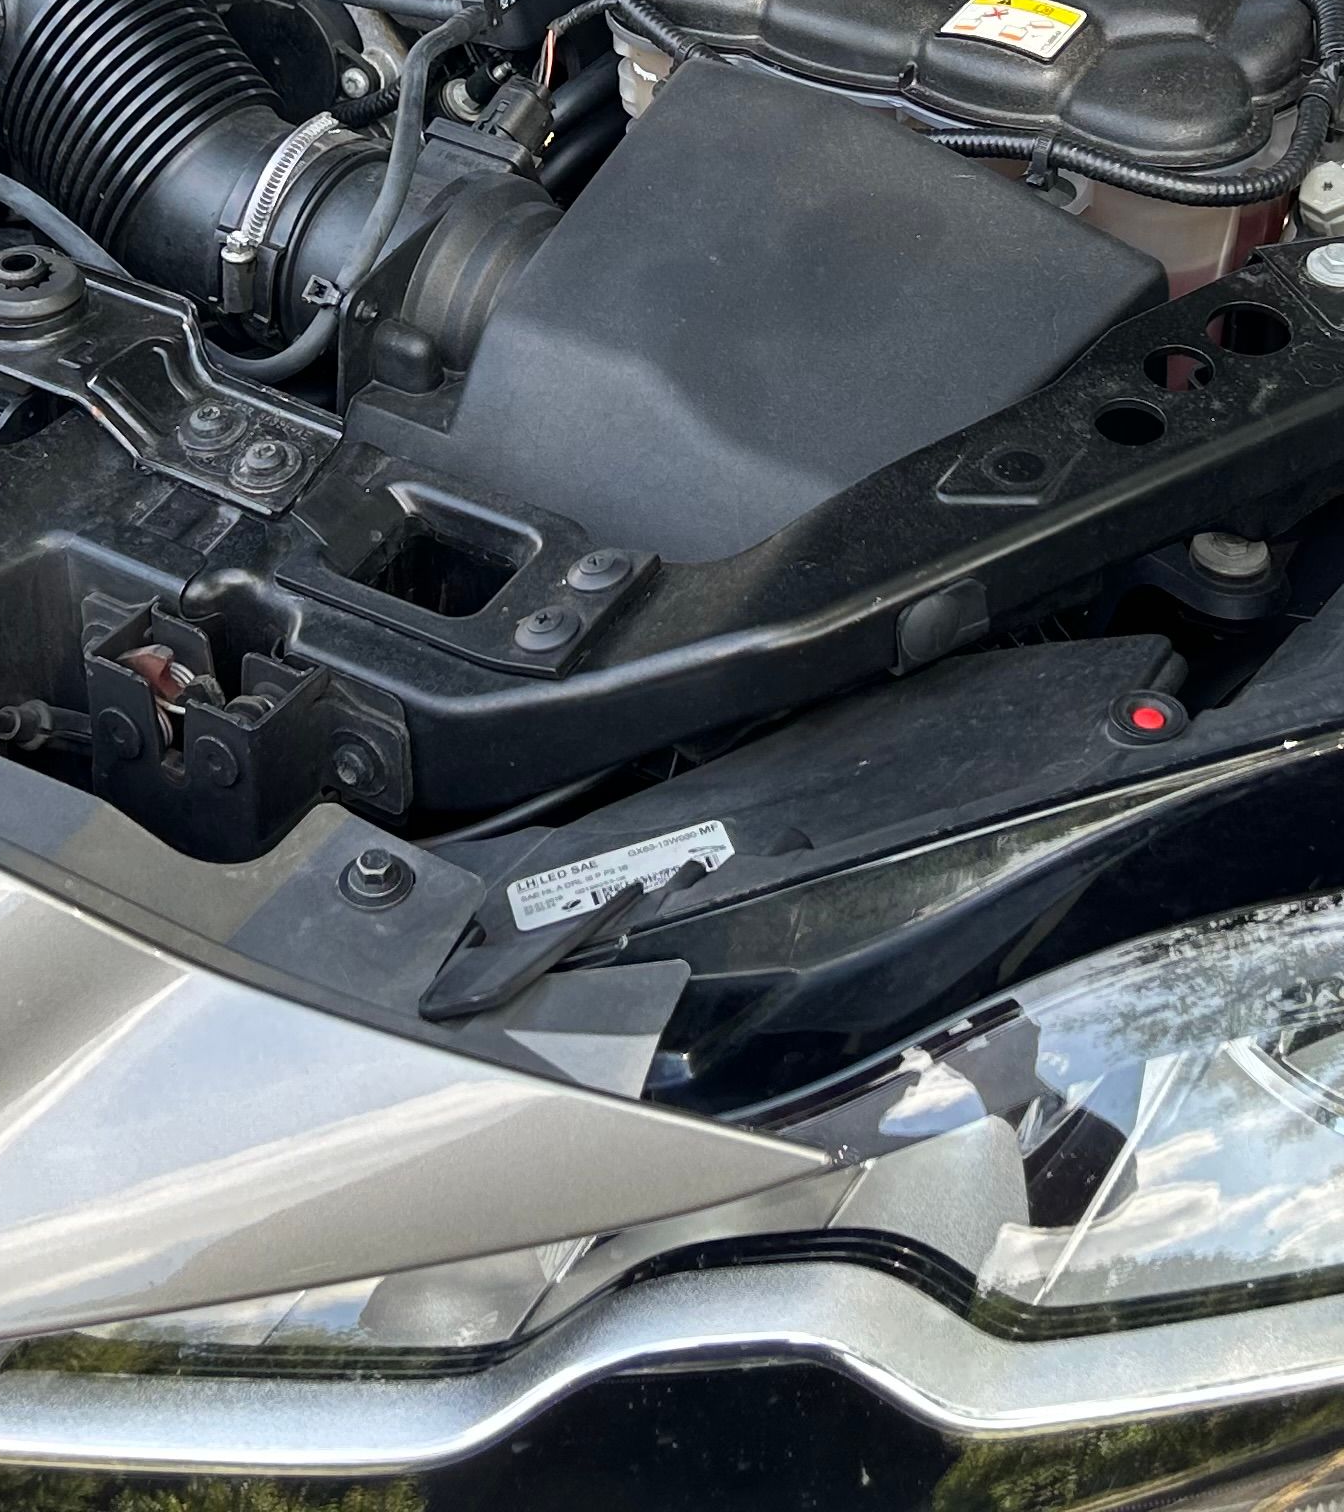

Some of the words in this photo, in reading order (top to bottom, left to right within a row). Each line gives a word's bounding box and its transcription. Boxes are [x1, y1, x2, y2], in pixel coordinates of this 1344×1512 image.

[517, 878, 537, 892] LH
[539, 868, 567, 884] LED
[570, 860, 598, 875] SAE
